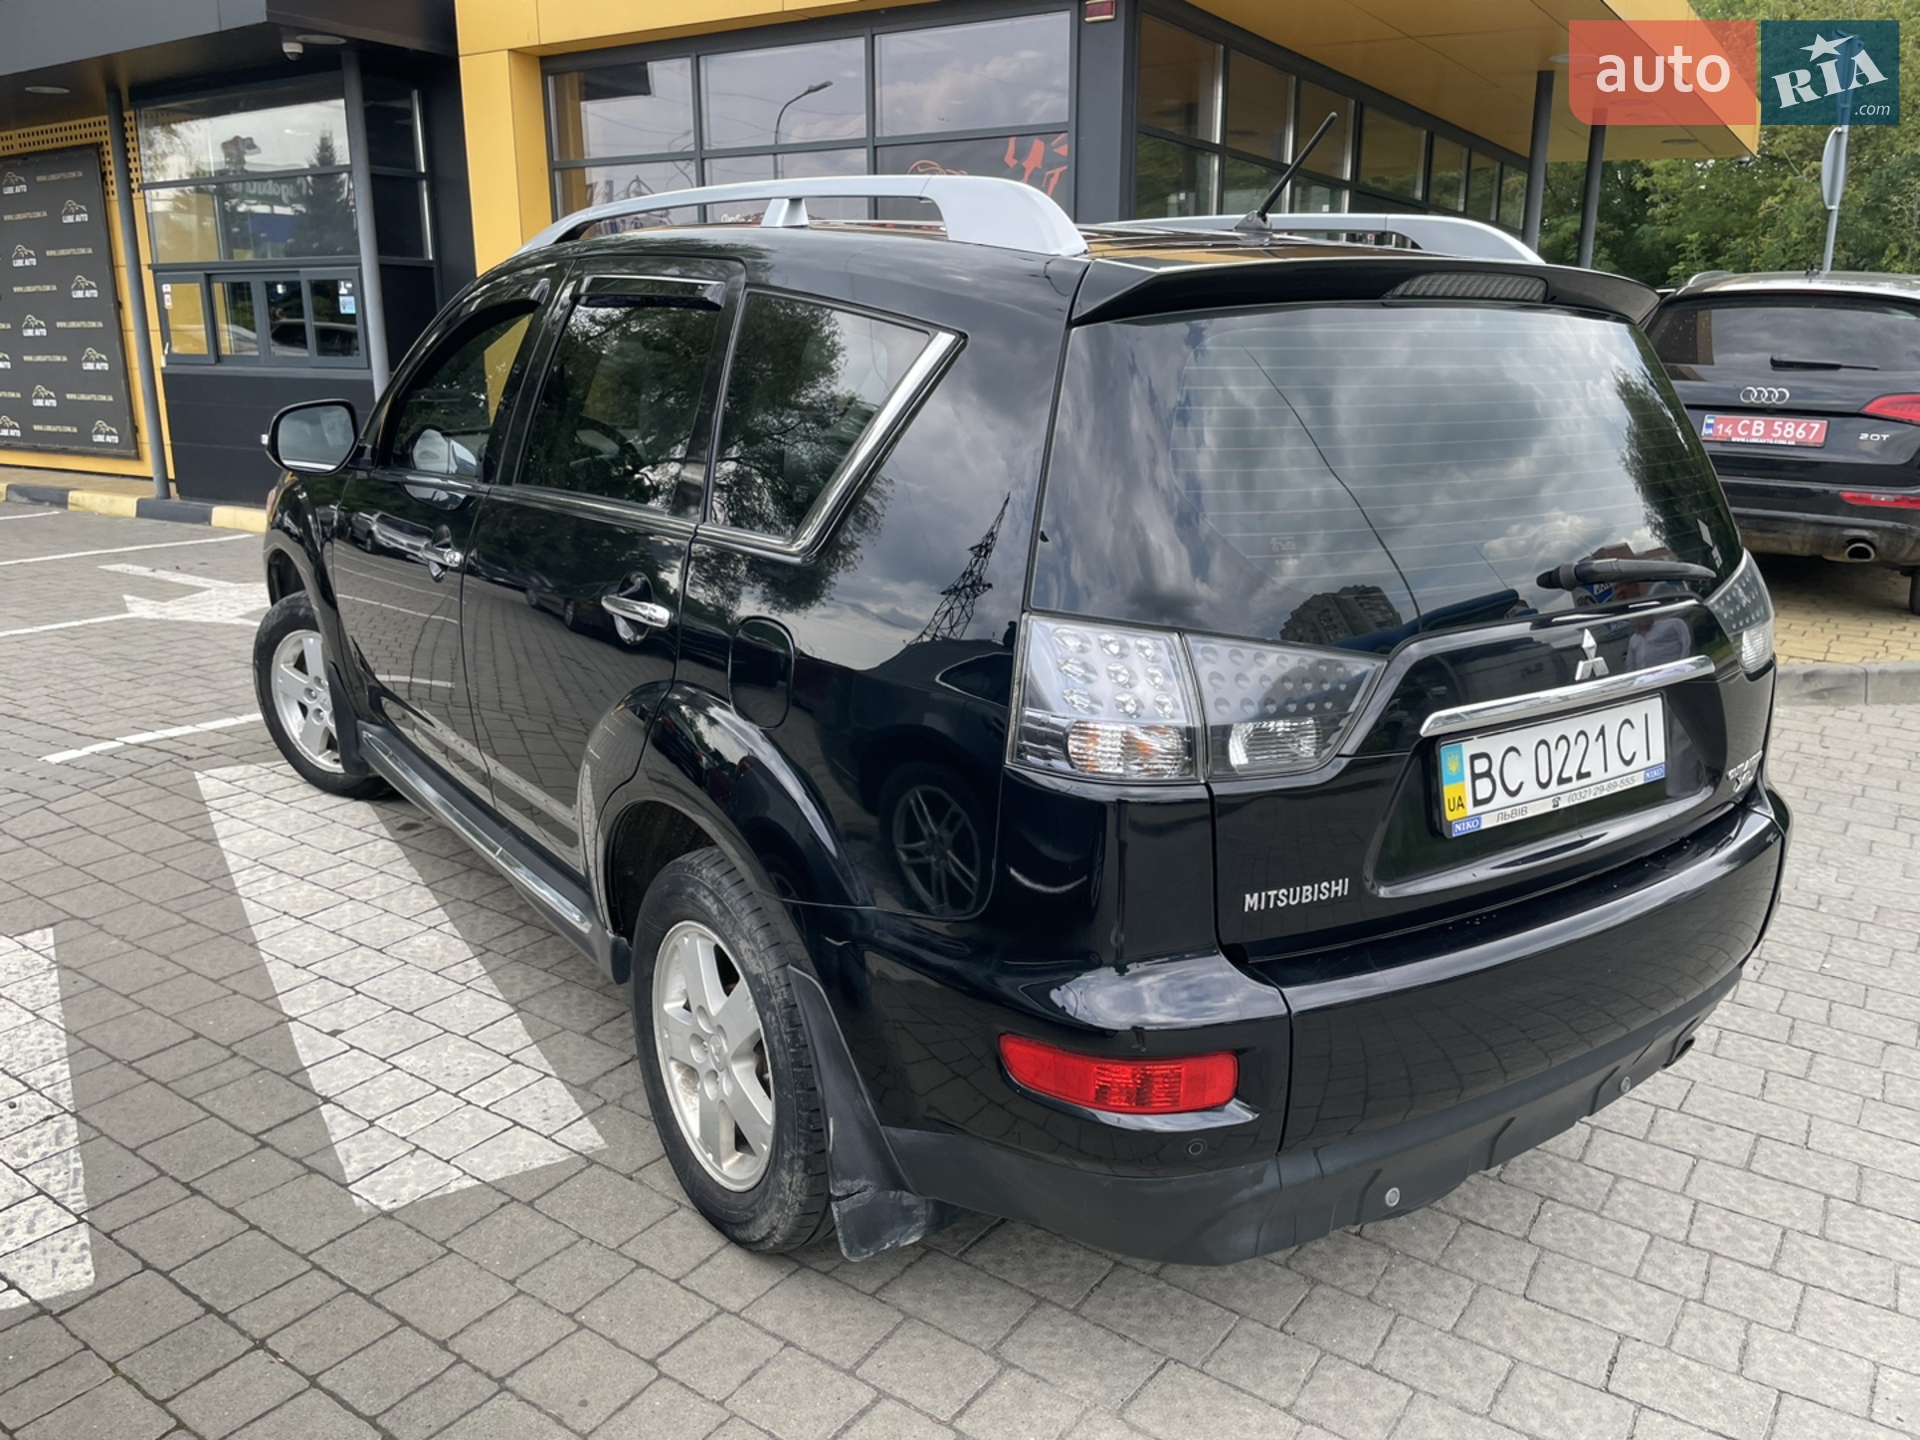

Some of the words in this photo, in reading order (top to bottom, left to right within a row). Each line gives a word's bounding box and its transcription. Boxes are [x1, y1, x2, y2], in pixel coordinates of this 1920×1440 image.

[1717, 423, 1733, 436] 14
[1737, 420, 1765, 436] CB
[1771, 421, 1821, 440] 5867
[1469, 746, 1524, 808] BC
[1534, 724, 1608, 790] 0221
[1616, 713, 1651, 767] CI
[1447, 795, 1465, 812] UA
[1567, 788, 1592, 804] (032)
[1455, 819, 1480, 833] NIKO
[1244, 877, 1349, 912] MITSUBISHI
